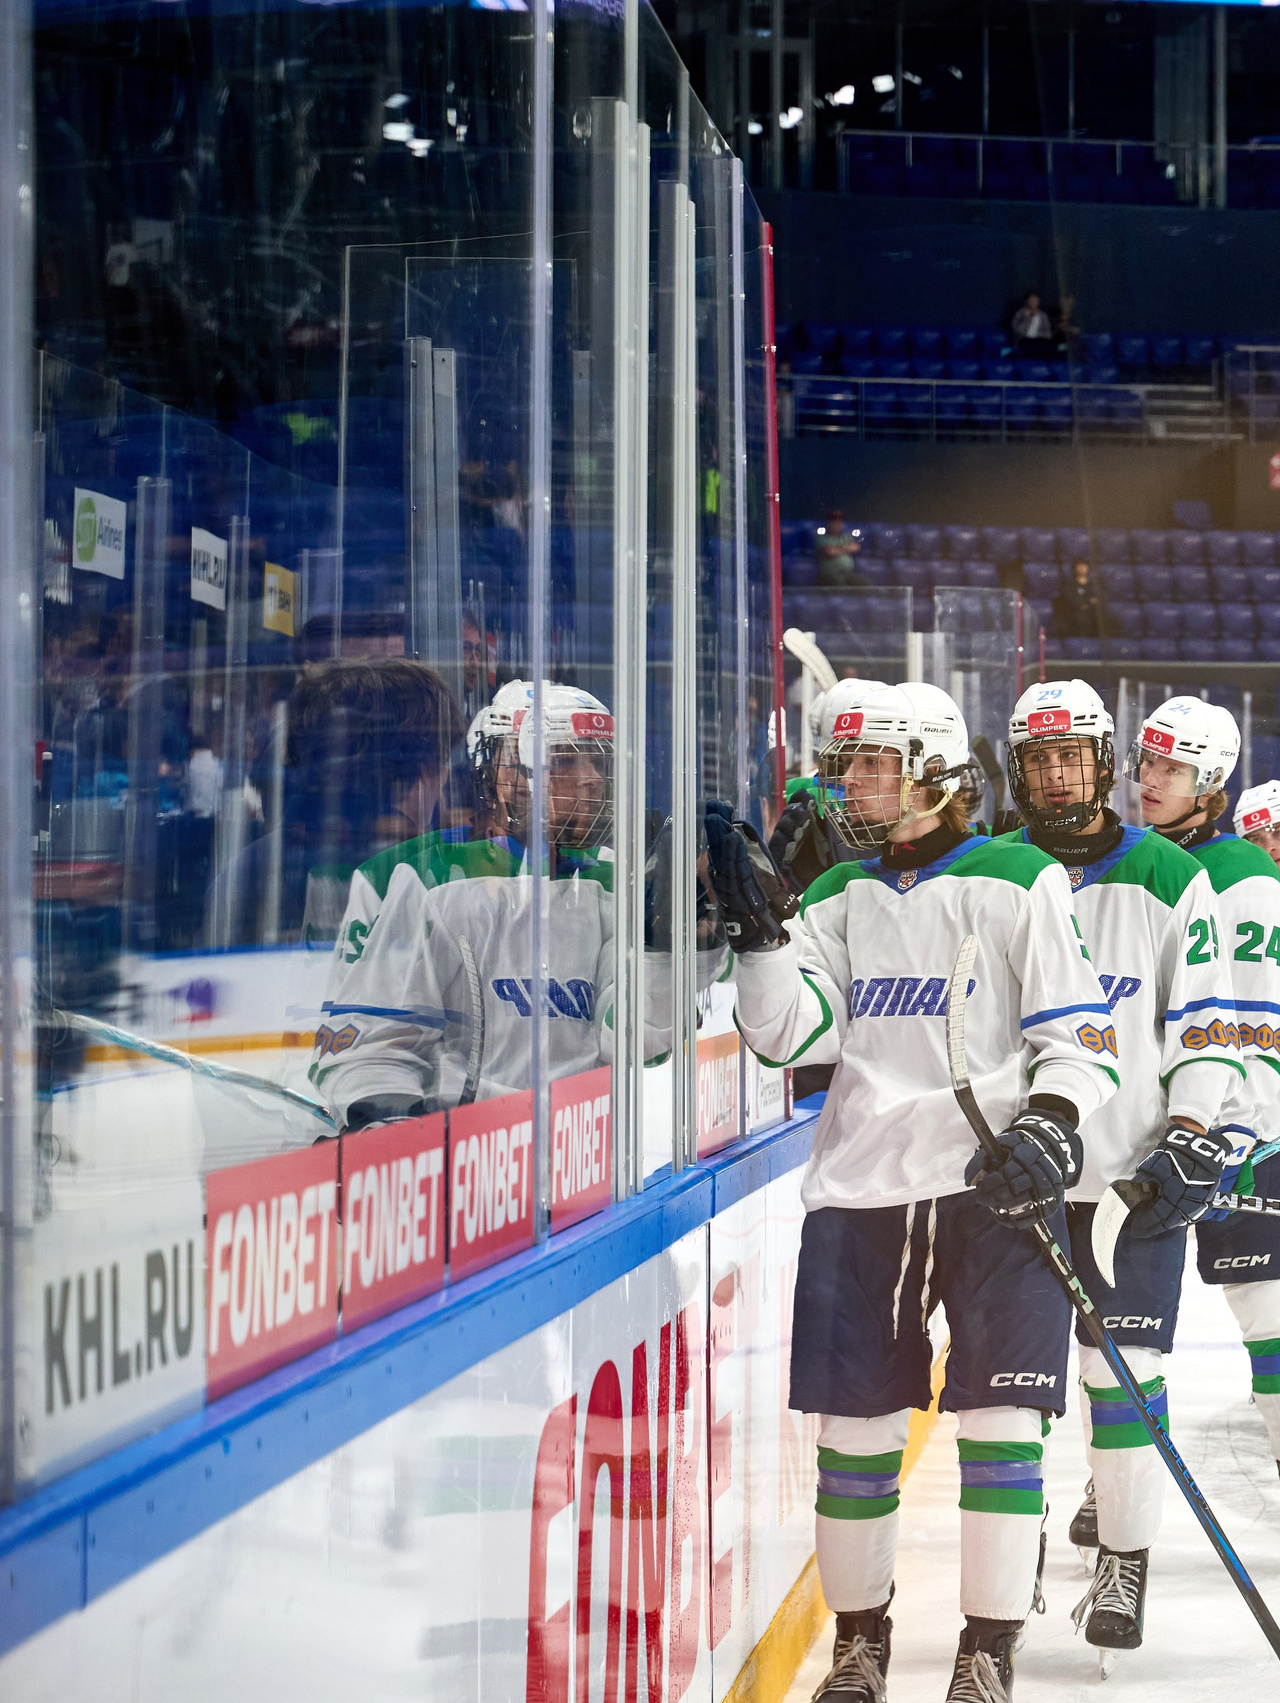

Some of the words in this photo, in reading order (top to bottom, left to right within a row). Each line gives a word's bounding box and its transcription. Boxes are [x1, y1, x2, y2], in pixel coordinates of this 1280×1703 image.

[1037, 689, 1063, 702] 29
[1167, 703, 1192, 716] 24
[1030, 724, 1069, 734] OLIMPBET
[1142, 739, 1171, 754] OLIMPBET
[1220, 750, 1236, 758] CCM
[1045, 815, 1077, 828] CCM
[551, 1094, 611, 1203] FONBET
[1013, 1114, 1076, 1173] CCM
[452, 1120, 533, 1249] FONBET
[344, 1147, 444, 1295] FONBET
[209, 1181, 337, 1357] FONBET
[1212, 1253, 1272, 1270] CCM
[43, 1239, 196, 1416] KHL.RU
[1102, 1314, 1164, 1331] CCM
[989, 1371, 1058, 1389] CCM
[1138, 1396, 1201, 1497] JETSPEED
